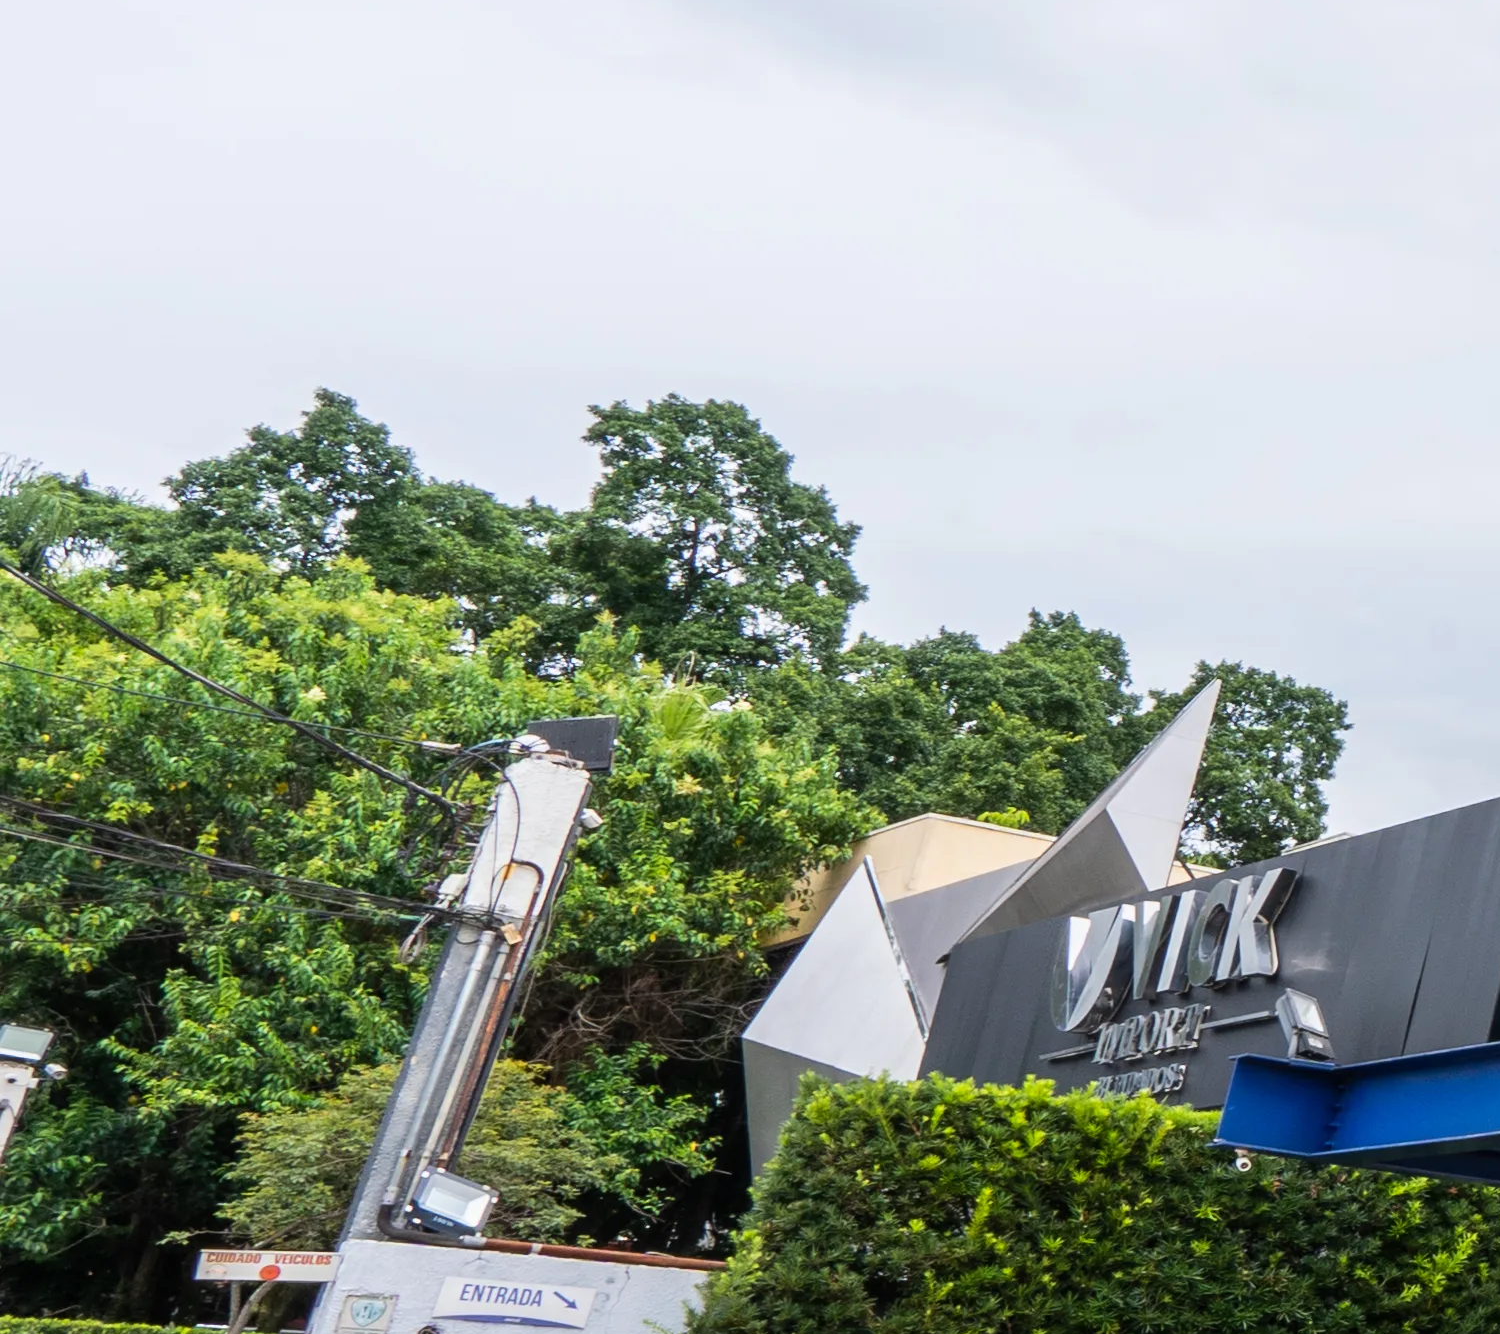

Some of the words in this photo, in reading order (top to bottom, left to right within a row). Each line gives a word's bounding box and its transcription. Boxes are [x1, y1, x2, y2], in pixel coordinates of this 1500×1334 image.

[206, 1252, 261, 1264] CUIDADO
[274, 1254, 332, 1265] VEICULOS
[460, 1283, 543, 1308] ENTRADA
